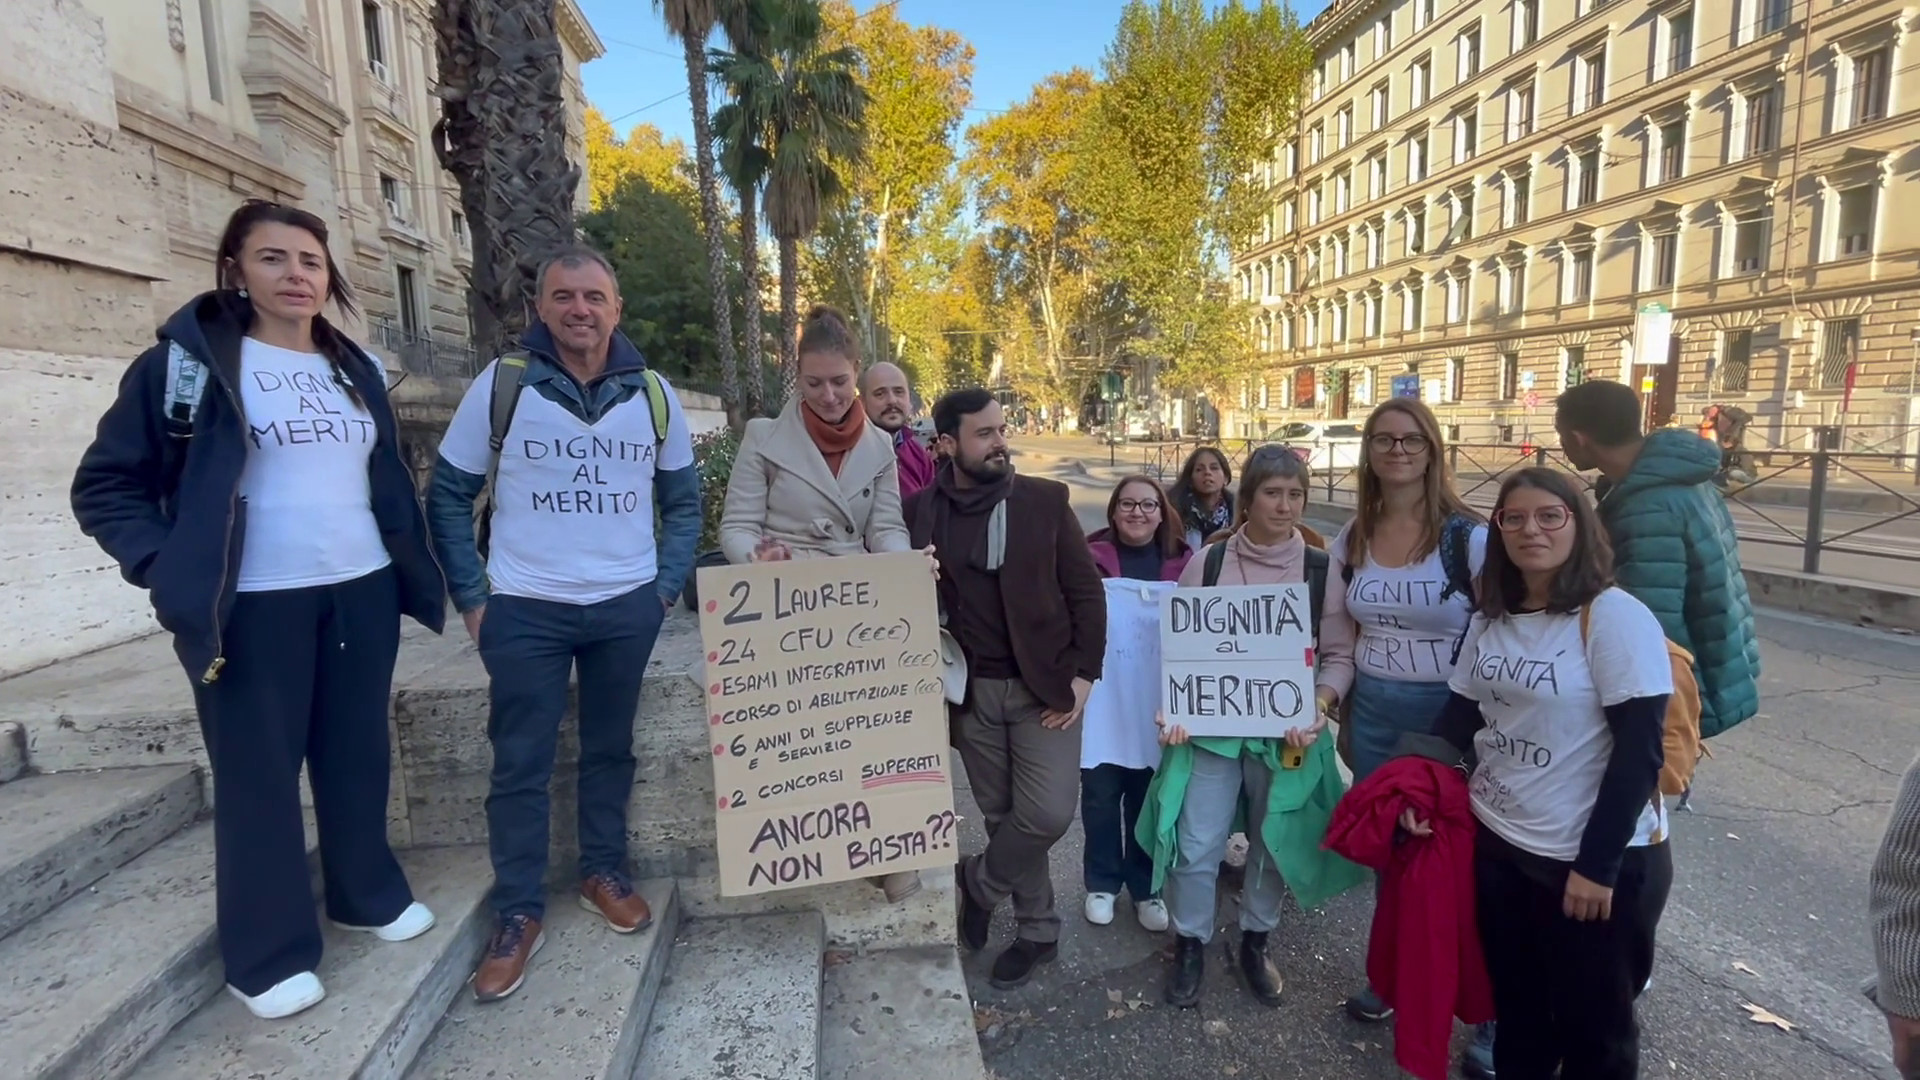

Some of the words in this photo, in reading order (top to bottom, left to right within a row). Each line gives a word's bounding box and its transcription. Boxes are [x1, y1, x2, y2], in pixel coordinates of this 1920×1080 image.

[253, 371, 341, 394] DIGNI
[300, 395, 341, 415] AL
[249, 419, 373, 449] MERIT
[572, 464, 608, 485] AL
[532, 490, 637, 514] MERITO
[723, 581, 762, 625] 2
[1172, 588, 1303, 636] DIGNITÀ
[718, 638, 756, 666] 24
[780, 628, 833, 652] CFU
[722, 671, 777, 696] ESAMI
[787, 658, 885, 685] INTEGRATIVI
[1169, 674, 1303, 718] MERITO
[722, 703, 780, 725] CORSO
[787, 700, 802, 714] DI
[809, 684, 908, 709] ABILITAZIONE
[730, 735, 746, 757] 6
[755, 732, 791, 752] ANNI
[800, 727, 815, 740] DI
[825, 710, 913, 735] SUPPLENZE
[749, 758, 759, 770] E
[778, 740, 852, 763] SERVIZIO
[731, 790, 747, 808] 2
[758, 769, 843, 799] CONCORSI
[861, 754, 941, 779] SUPERATI
[749, 801, 871, 853] ANCORA
[749, 852, 823, 887] NON
